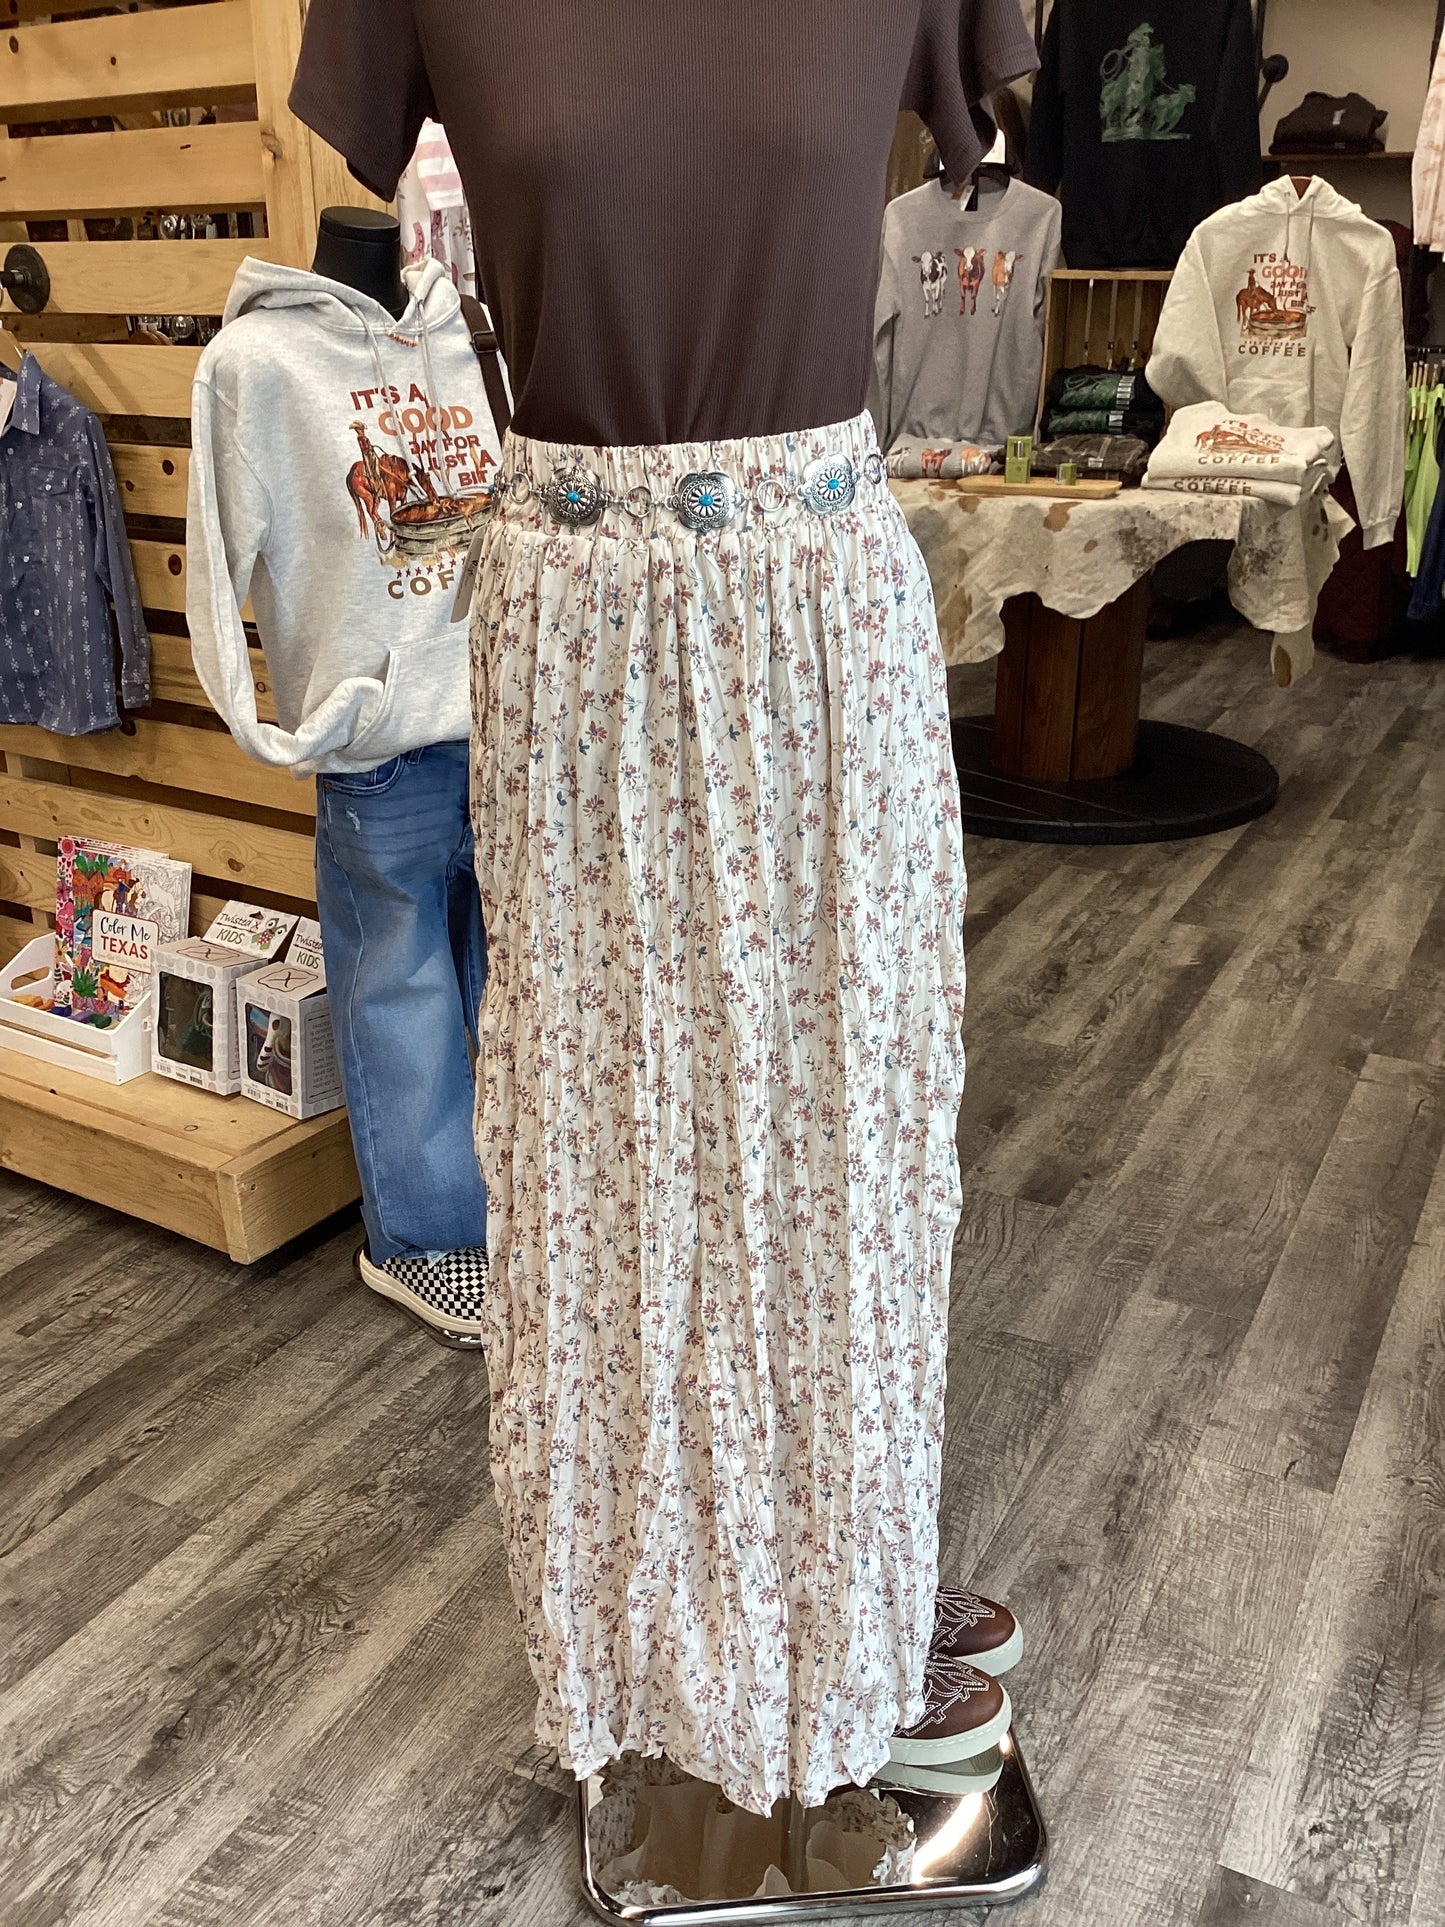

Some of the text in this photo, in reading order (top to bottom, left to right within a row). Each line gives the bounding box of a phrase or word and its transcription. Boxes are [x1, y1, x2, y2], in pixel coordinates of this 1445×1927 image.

[1238, 345, 1306, 357] COFFEE
[350, 383, 426, 411] IT'S A
[378, 405, 473, 437] GOOD
[442, 435, 481, 451] FOR
[480, 449, 497, 468] A
[1198, 456, 1280, 465] COFFEE
[1174, 481, 1252, 495] COFFEE
[387, 568, 455, 600] COF
[100, 916, 151, 942] Color Me
[220, 912, 252, 927] Twisted
[216, 928, 245, 944] KIDS
[100, 935, 148, 960] TEXAS
[296, 951, 320, 970] KIDS
